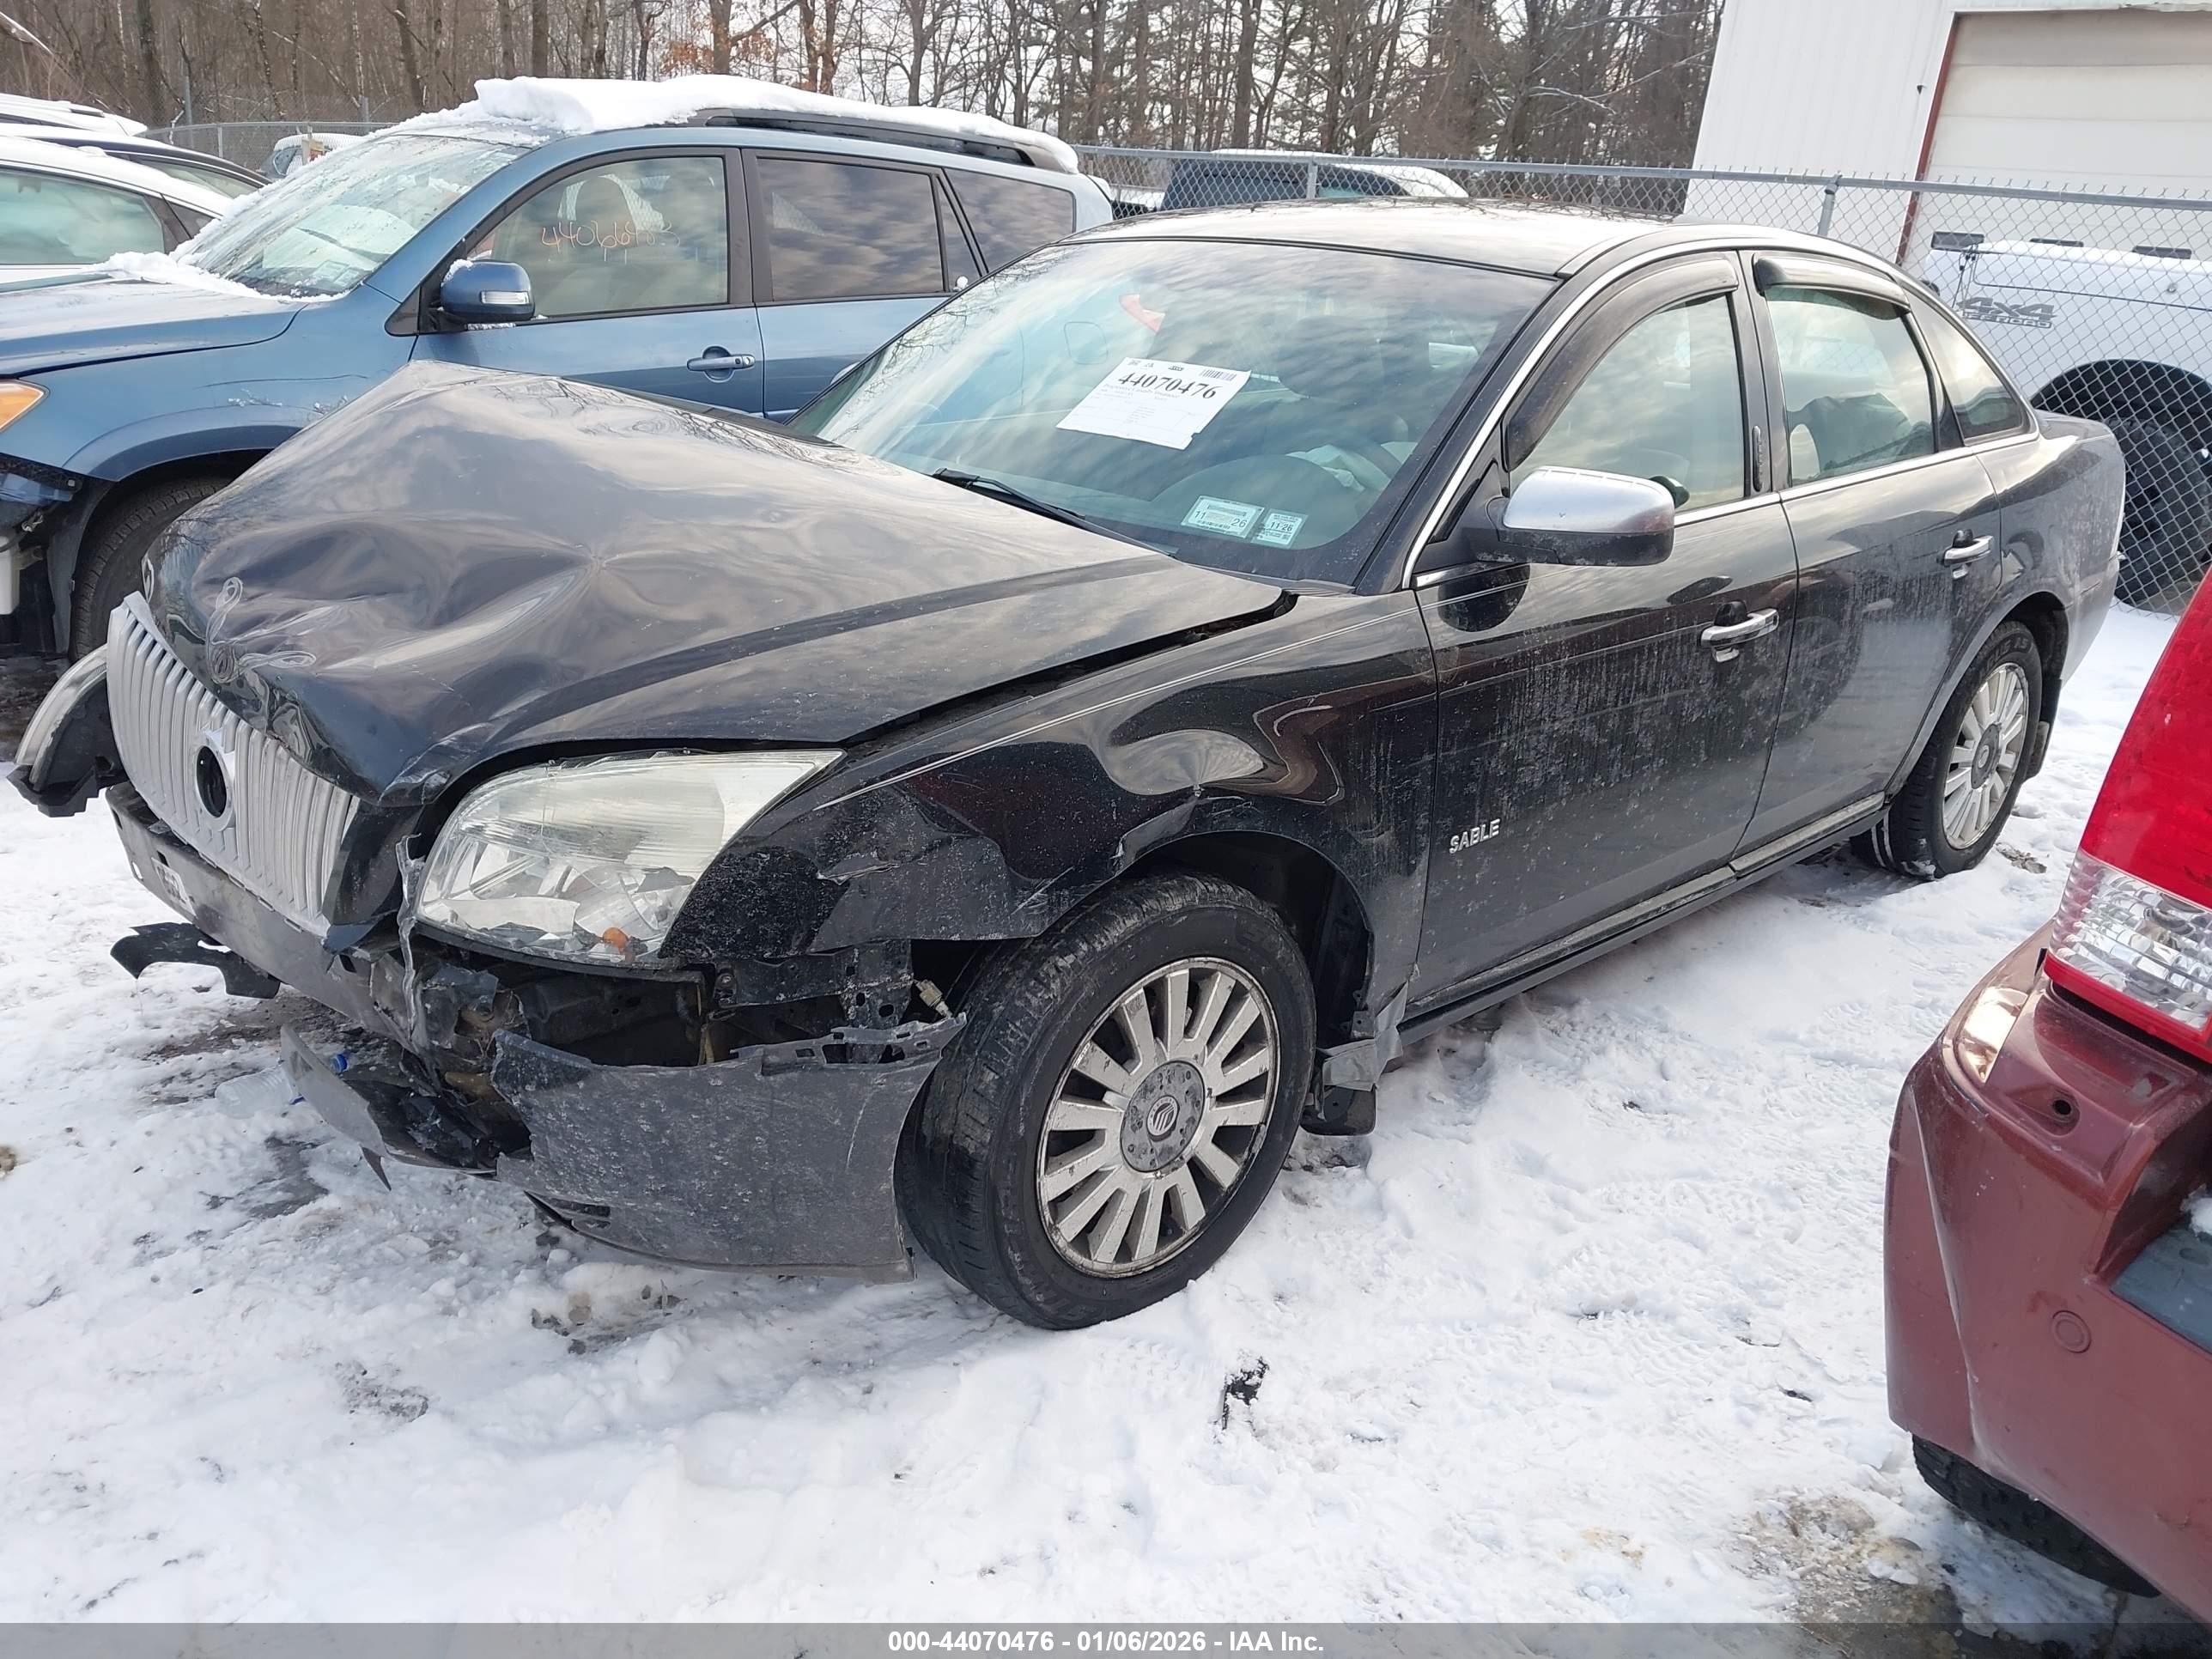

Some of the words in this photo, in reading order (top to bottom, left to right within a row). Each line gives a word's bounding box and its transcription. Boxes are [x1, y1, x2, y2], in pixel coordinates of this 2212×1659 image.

[1995, 314, 2052, 328] ROAD
[1117, 372, 1223, 399] 44070476
[1231, 518, 1248, 528] 26
[1449, 818, 1501, 854] SABLE
